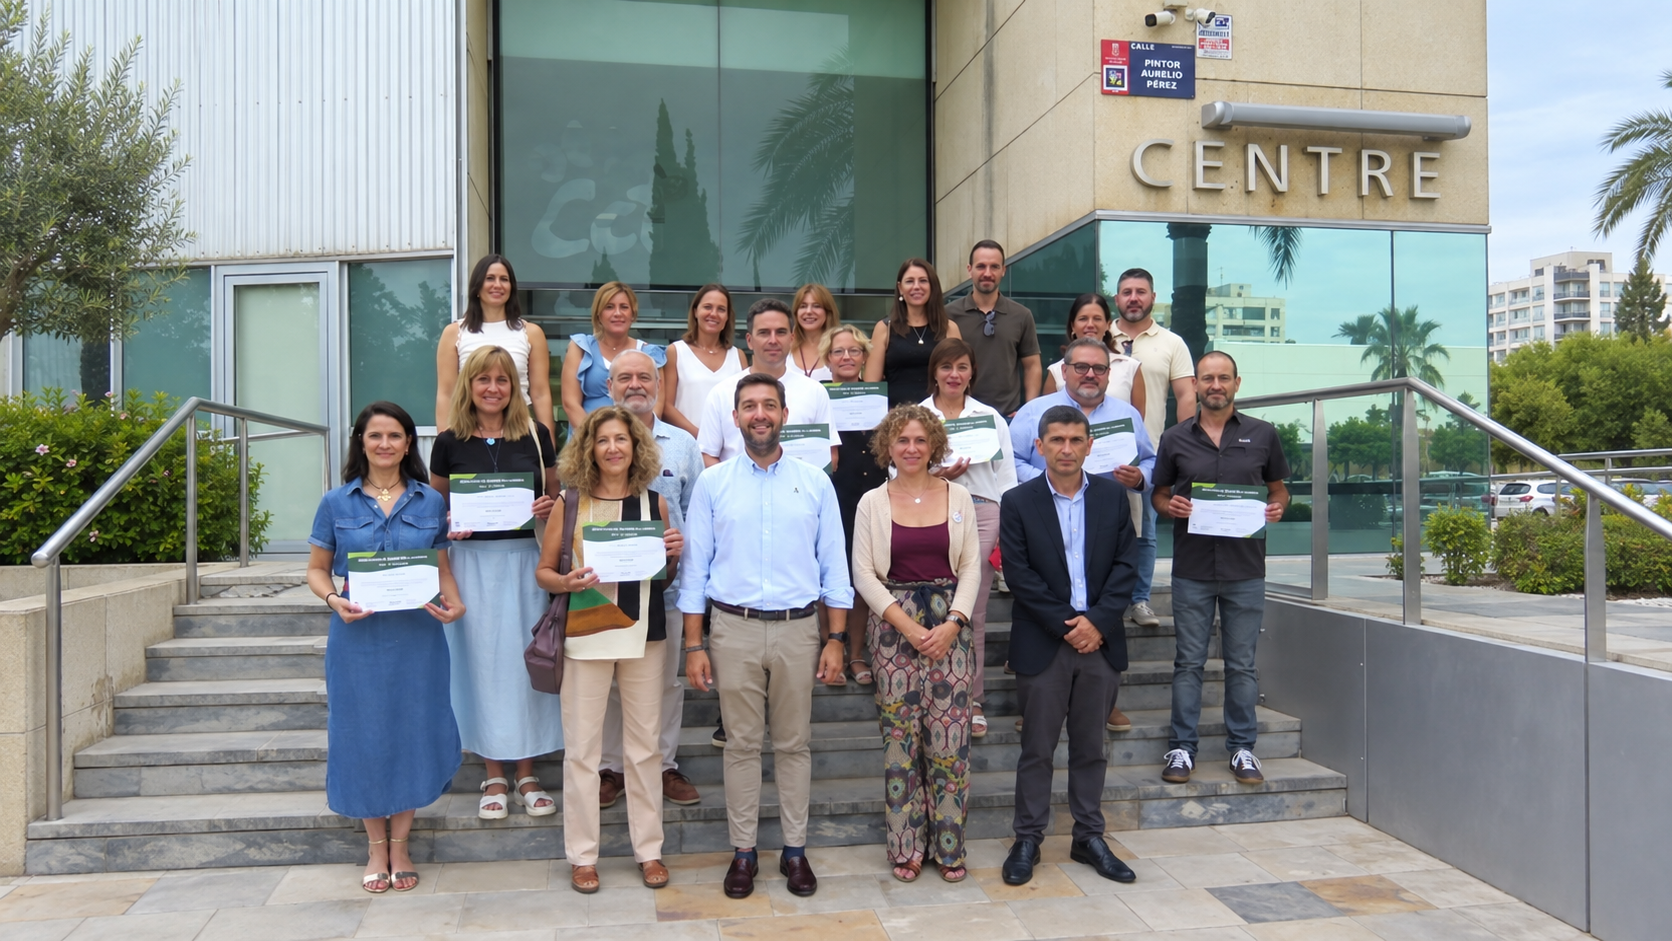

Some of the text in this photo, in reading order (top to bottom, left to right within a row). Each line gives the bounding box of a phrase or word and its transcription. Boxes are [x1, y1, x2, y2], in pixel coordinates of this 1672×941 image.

[1130, 42, 1155, 51] CALLE
[1144, 59, 1181, 69] PINTOR
[1140, 69, 1183, 79] AURELIO
[1146, 79, 1178, 90] PÉREZ
[1129, 138, 1441, 200] CENTRE
